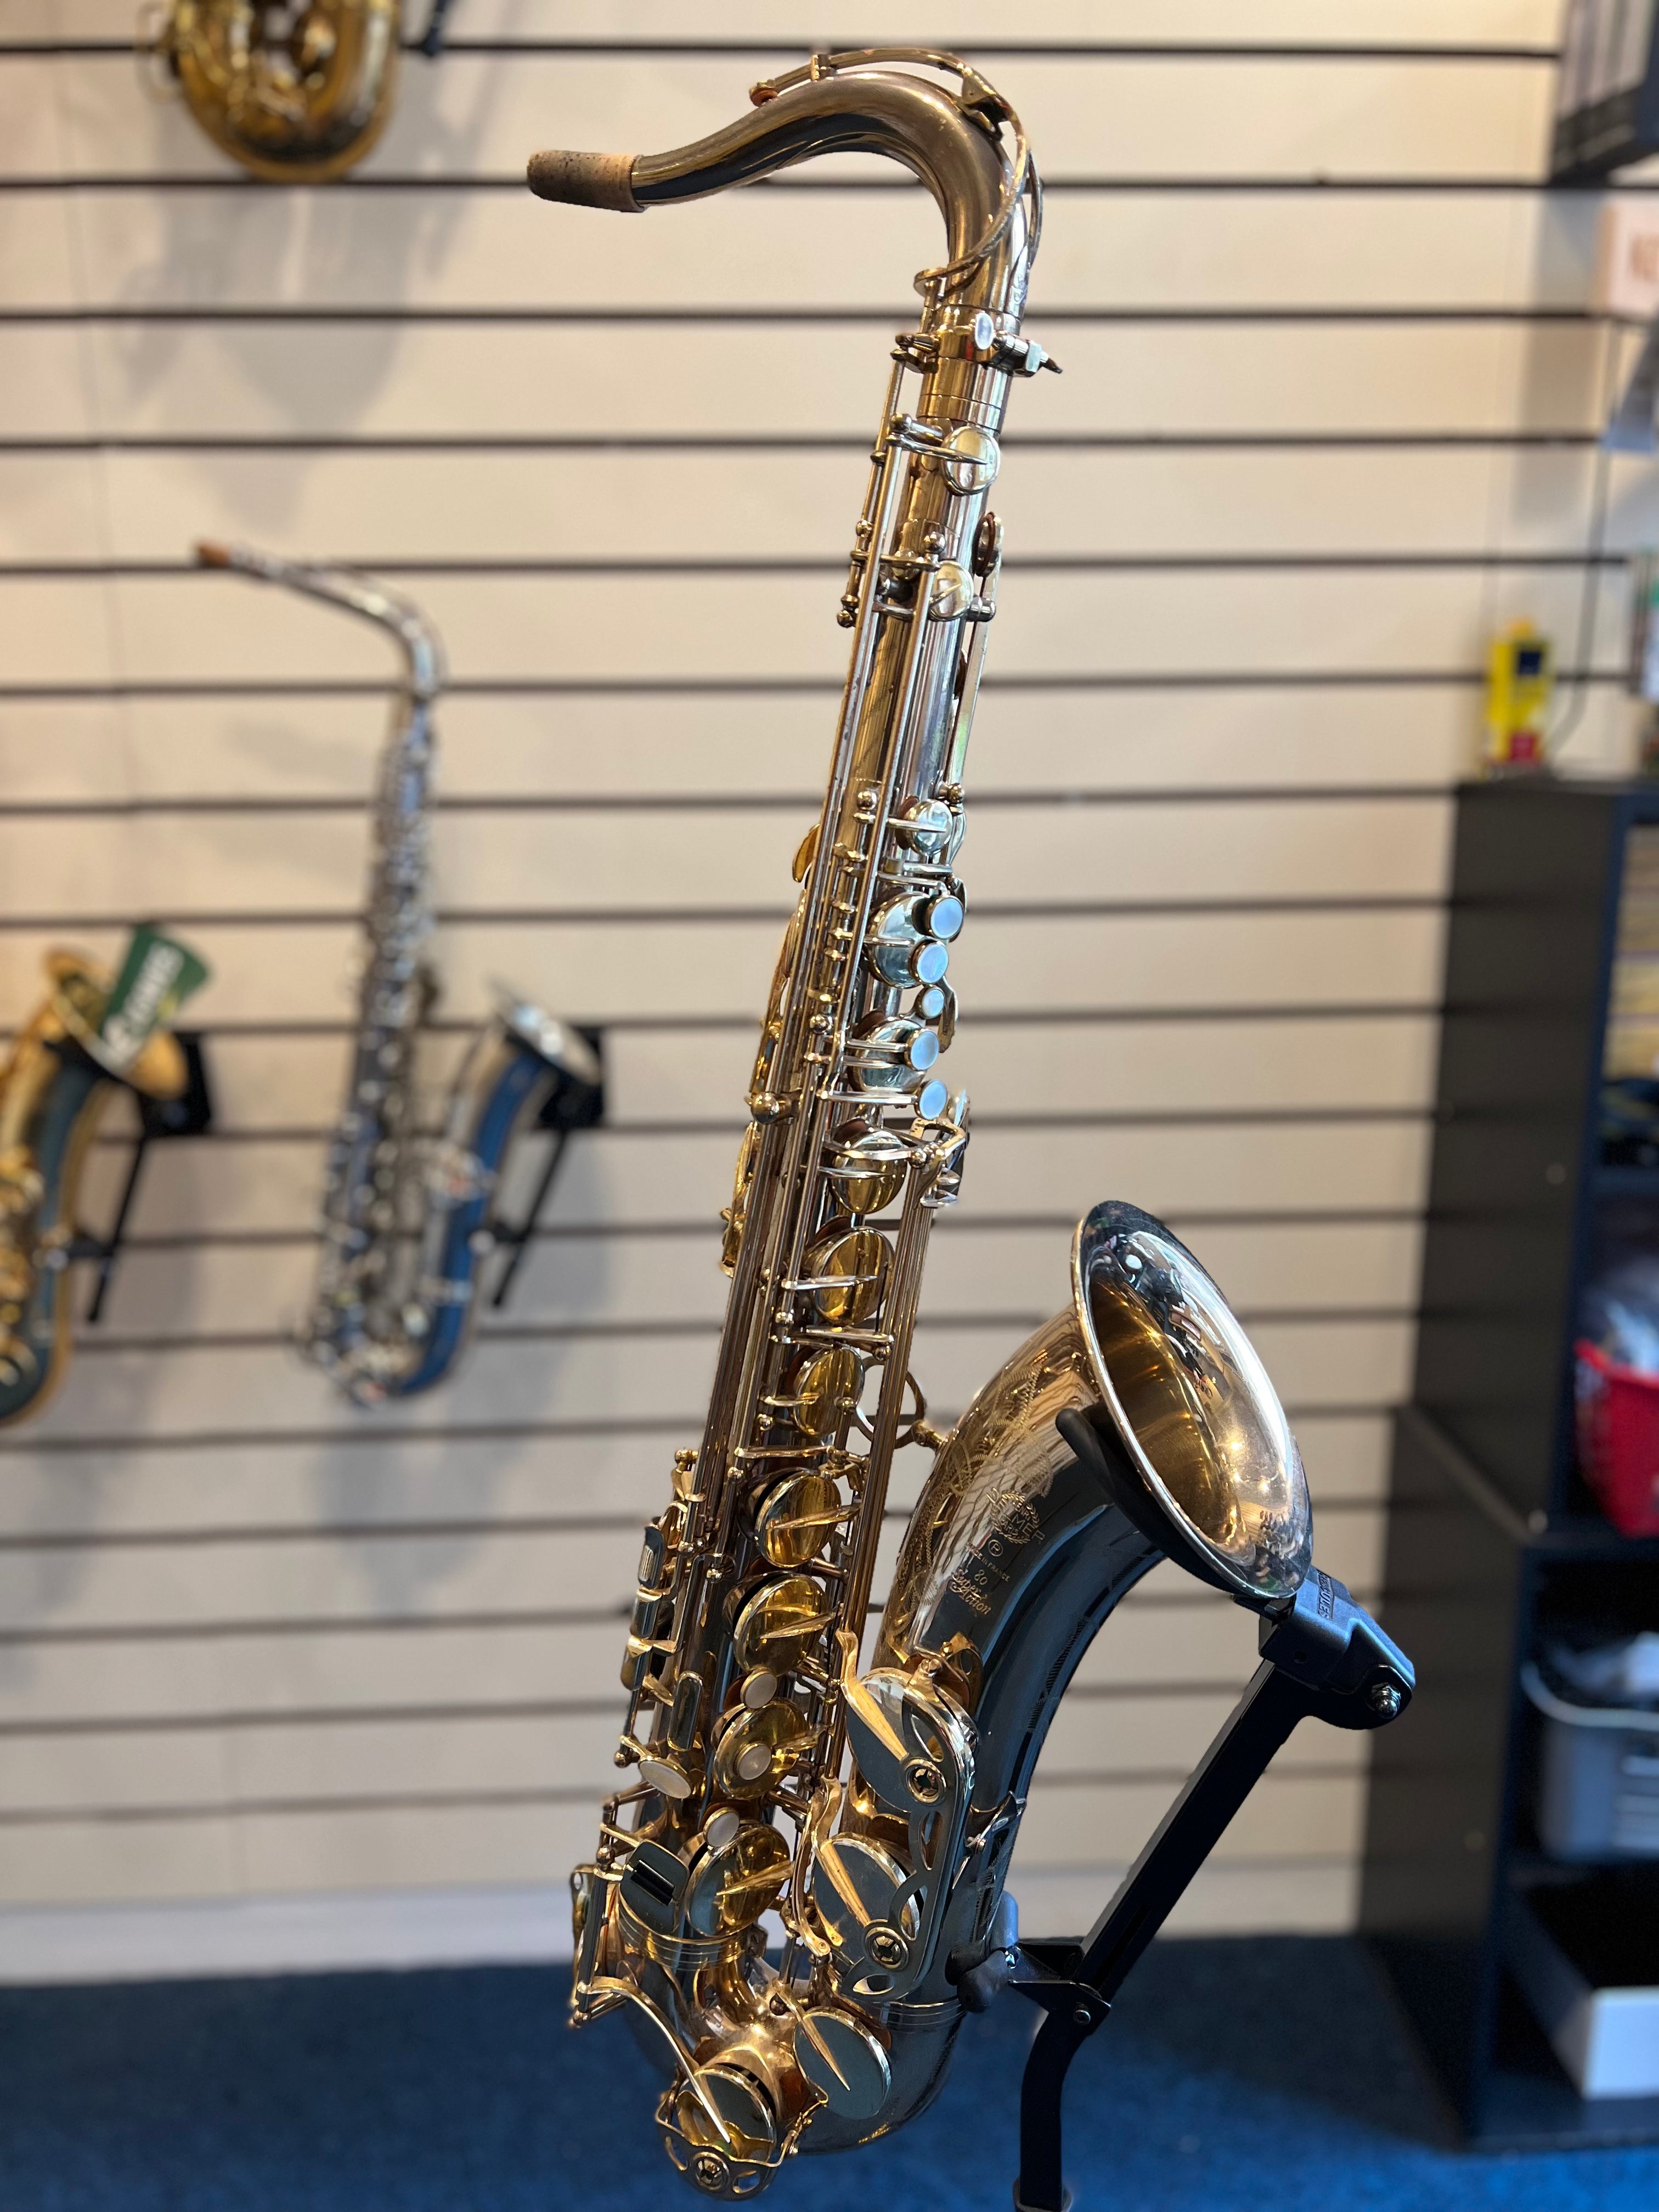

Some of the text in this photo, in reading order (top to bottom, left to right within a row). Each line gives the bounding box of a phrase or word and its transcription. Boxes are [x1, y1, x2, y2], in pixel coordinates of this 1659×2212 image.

[974, 1570, 988, 1585] 80
[988, 1562, 1011, 1582] FRANCE
[950, 1582, 991, 1615] Action
